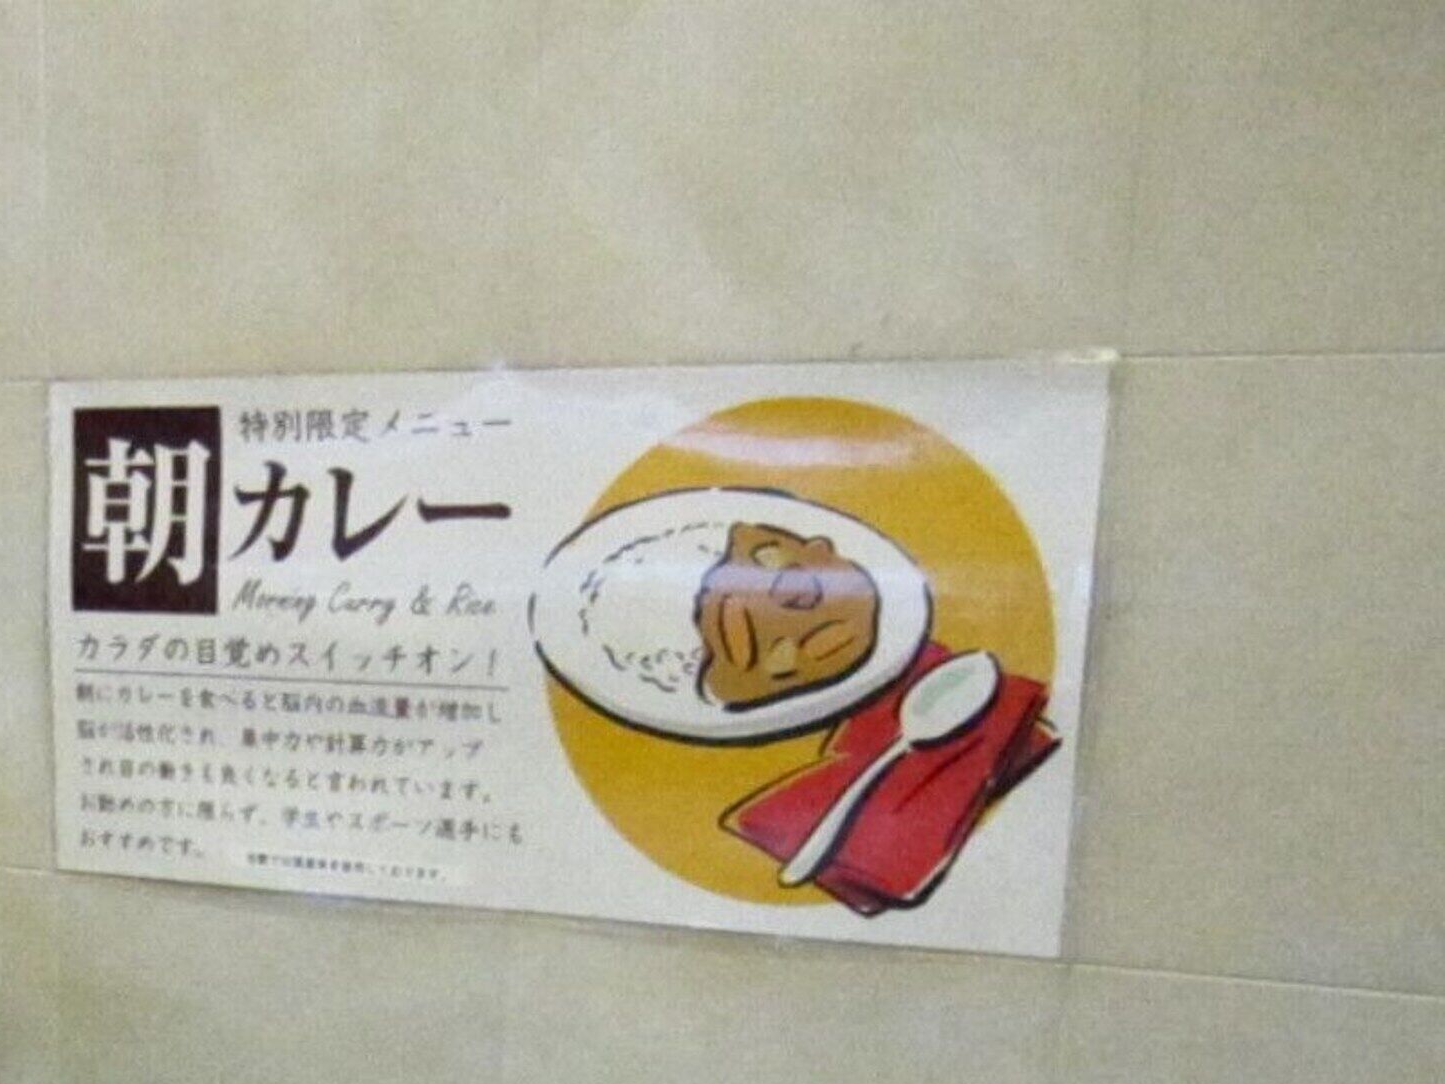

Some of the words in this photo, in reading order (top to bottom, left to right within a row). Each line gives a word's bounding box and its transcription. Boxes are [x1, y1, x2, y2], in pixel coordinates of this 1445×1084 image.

[238, 408, 512, 443] 特別限定メニュー
[229, 459, 512, 562] カレー
[328, 580, 396, 626] Curry
